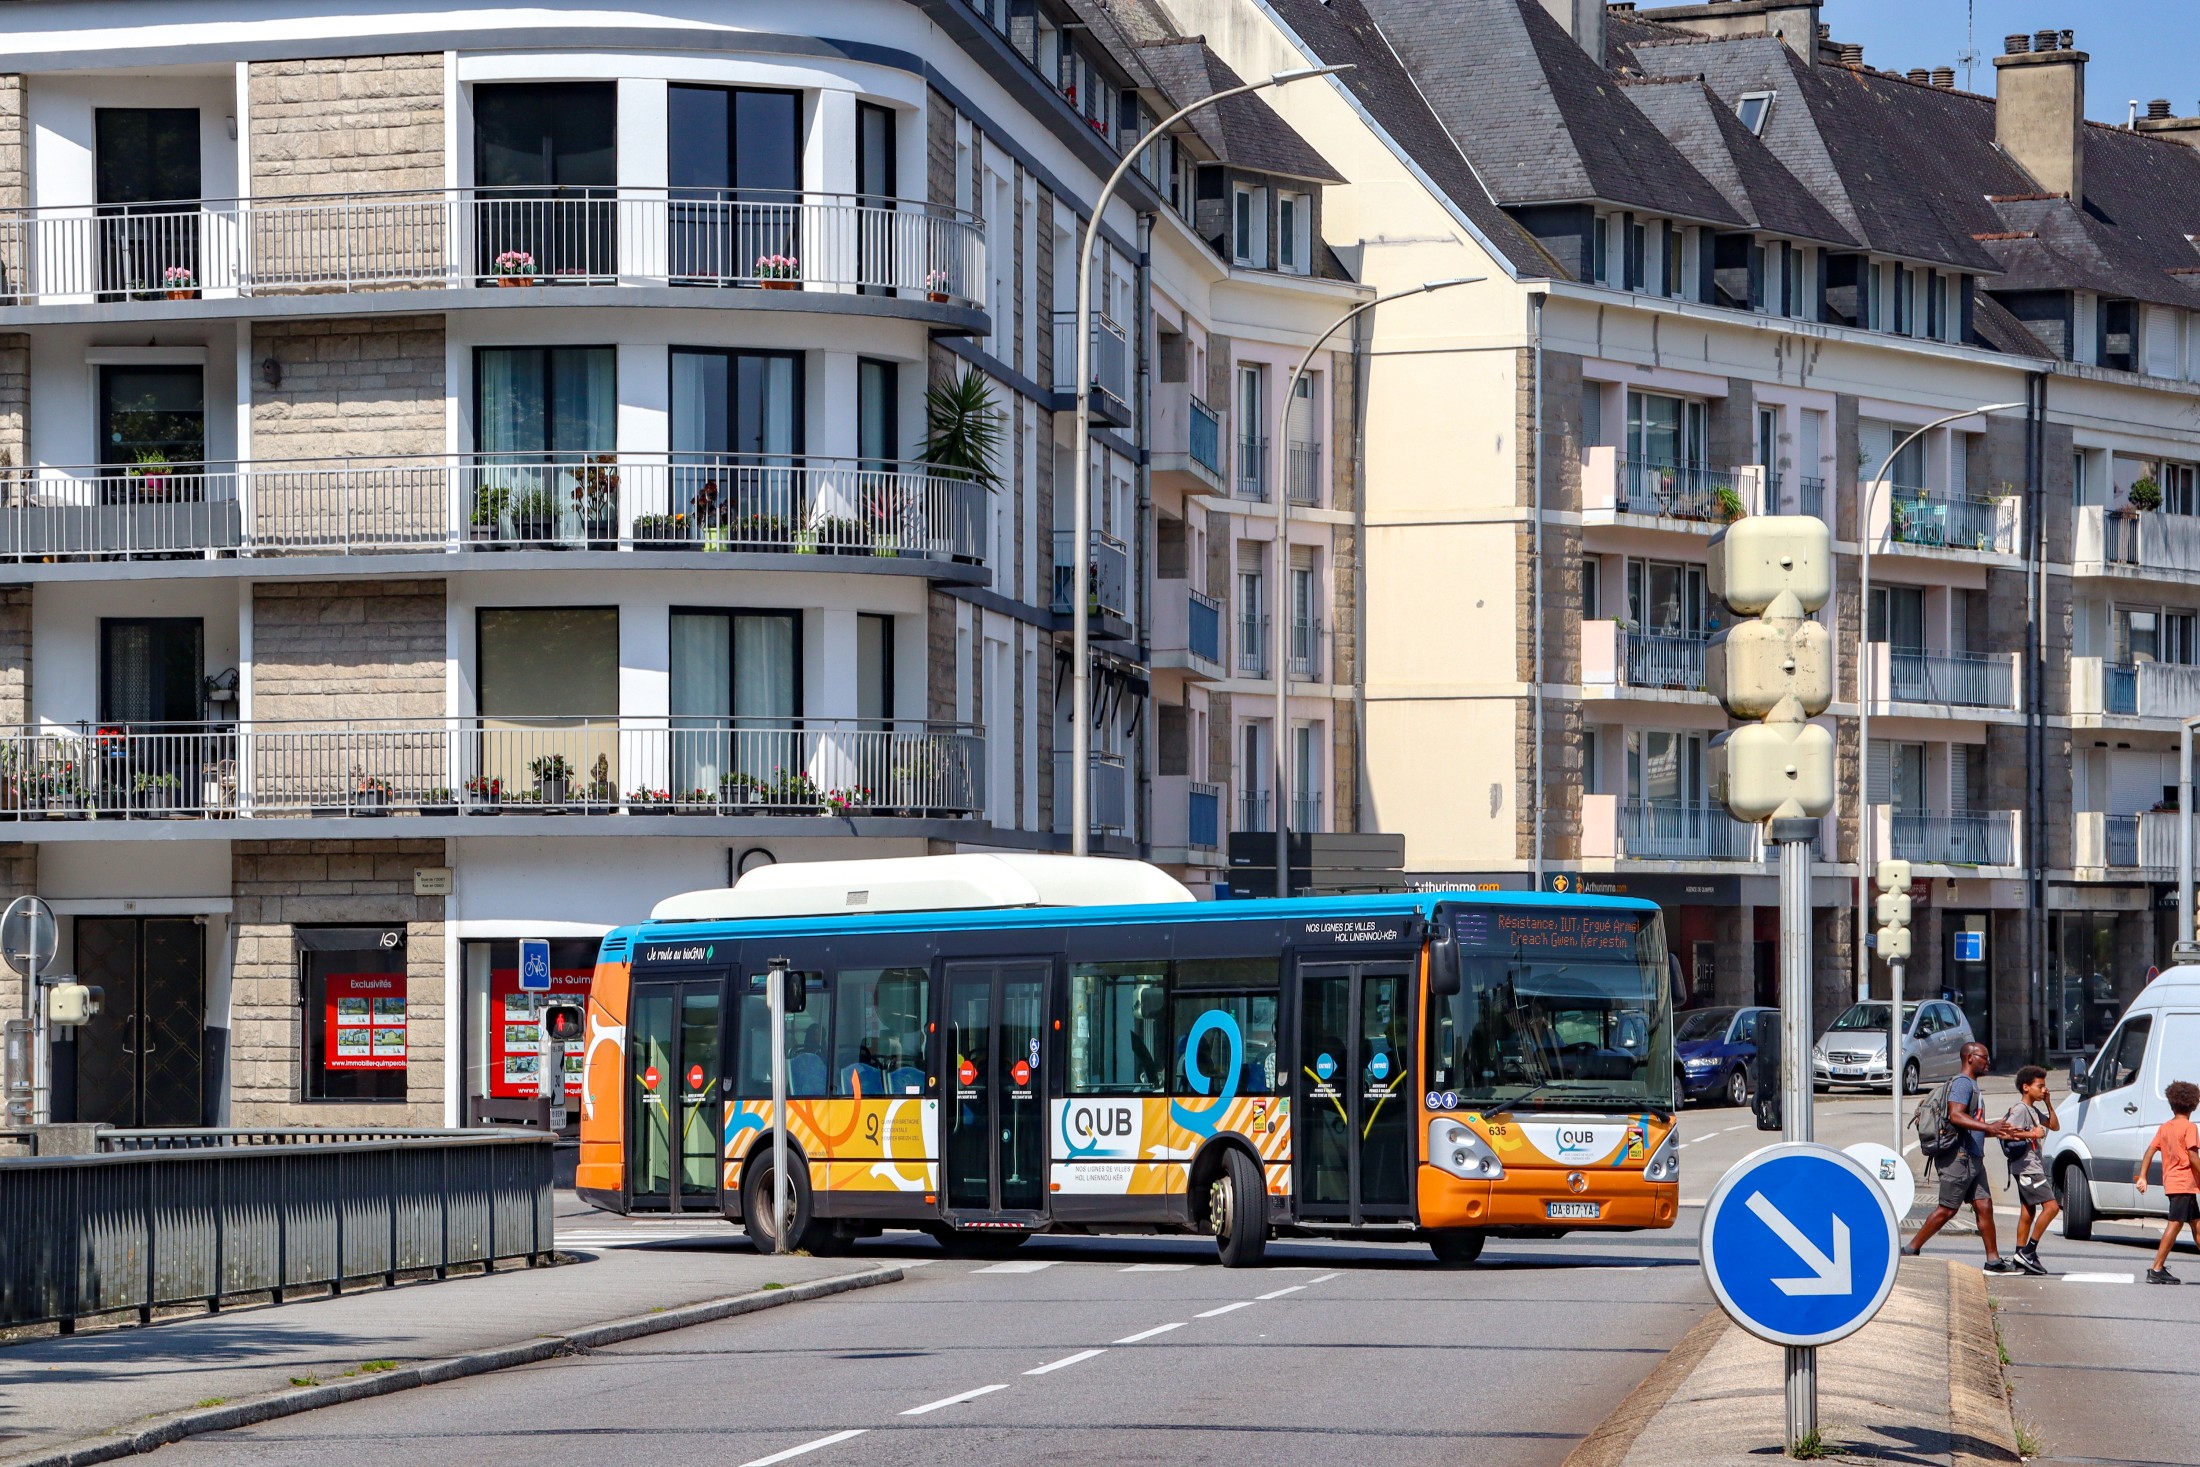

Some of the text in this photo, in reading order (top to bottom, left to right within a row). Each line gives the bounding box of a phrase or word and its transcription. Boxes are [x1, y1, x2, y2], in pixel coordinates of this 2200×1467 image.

[1305, 921, 1376, 933] NOS LIGNES DE VILLES
[1335, 933, 1348, 942] HOL
[646, 946, 657, 961] Je
[657, 946, 673, 960] roule
[673, 950, 682, 960] au
[350, 979, 392, 989] Exclusivités
[1075, 1108, 1133, 1138] QUB
[1489, 1126, 1507, 1136] 635
[1563, 1131, 1594, 1144] QUB
[1075, 1174, 1086, 1182] HOL
[1552, 1203, 1594, 1216] DA-817-YA
